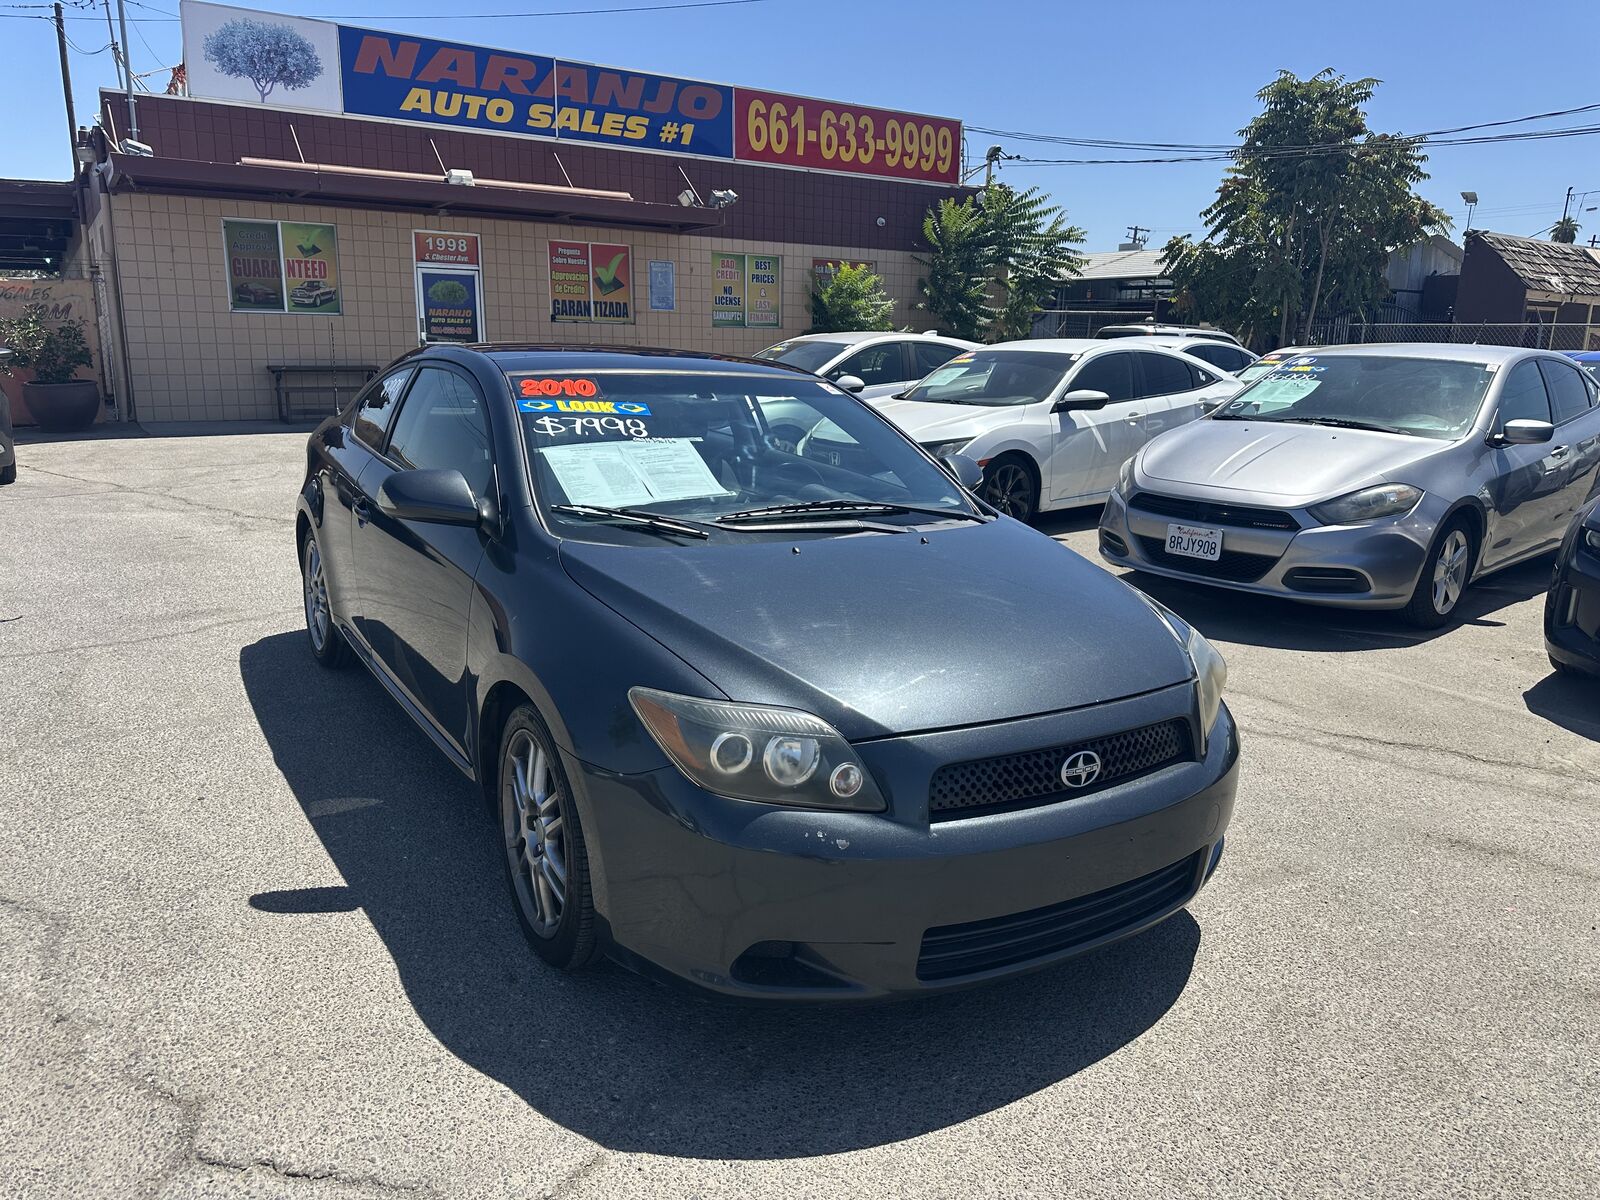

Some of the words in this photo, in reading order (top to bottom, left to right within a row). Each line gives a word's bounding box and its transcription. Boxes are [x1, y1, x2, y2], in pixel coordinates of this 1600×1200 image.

[353, 35, 723, 120] NARANJO
[400, 87, 514, 124] AUTO
[526, 103, 649, 140] SALES
[658, 121, 695, 146] #1
[747, 99, 952, 174] 661-633-9999
[238, 230, 269, 240] Credit
[232, 241, 275, 252] Approval
[425, 236, 467, 252] 1998
[431, 253, 457, 261] Chester
[552, 256, 568, 264] Sobre
[232, 256, 328, 280] GUARANTEED
[720, 259, 735, 269] BAD
[754, 260, 771, 271] BEST
[716, 270, 740, 280] CREDIT
[751, 273, 775, 284] PRICES
[554, 284, 563, 293] de
[563, 284, 585, 294] Credito
[723, 285, 733, 295] NO
[760, 287, 767, 298] &
[714, 295, 741, 306] LICENSE
[755, 300, 771, 310] EASY
[428, 308, 473, 317] NARANJO
[552, 299, 629, 318] GARANTIZADA
[520, 379, 597, 397] 2010
[556, 400, 619, 413] LOOK
[1169, 535, 1217, 556] 8RJY908
